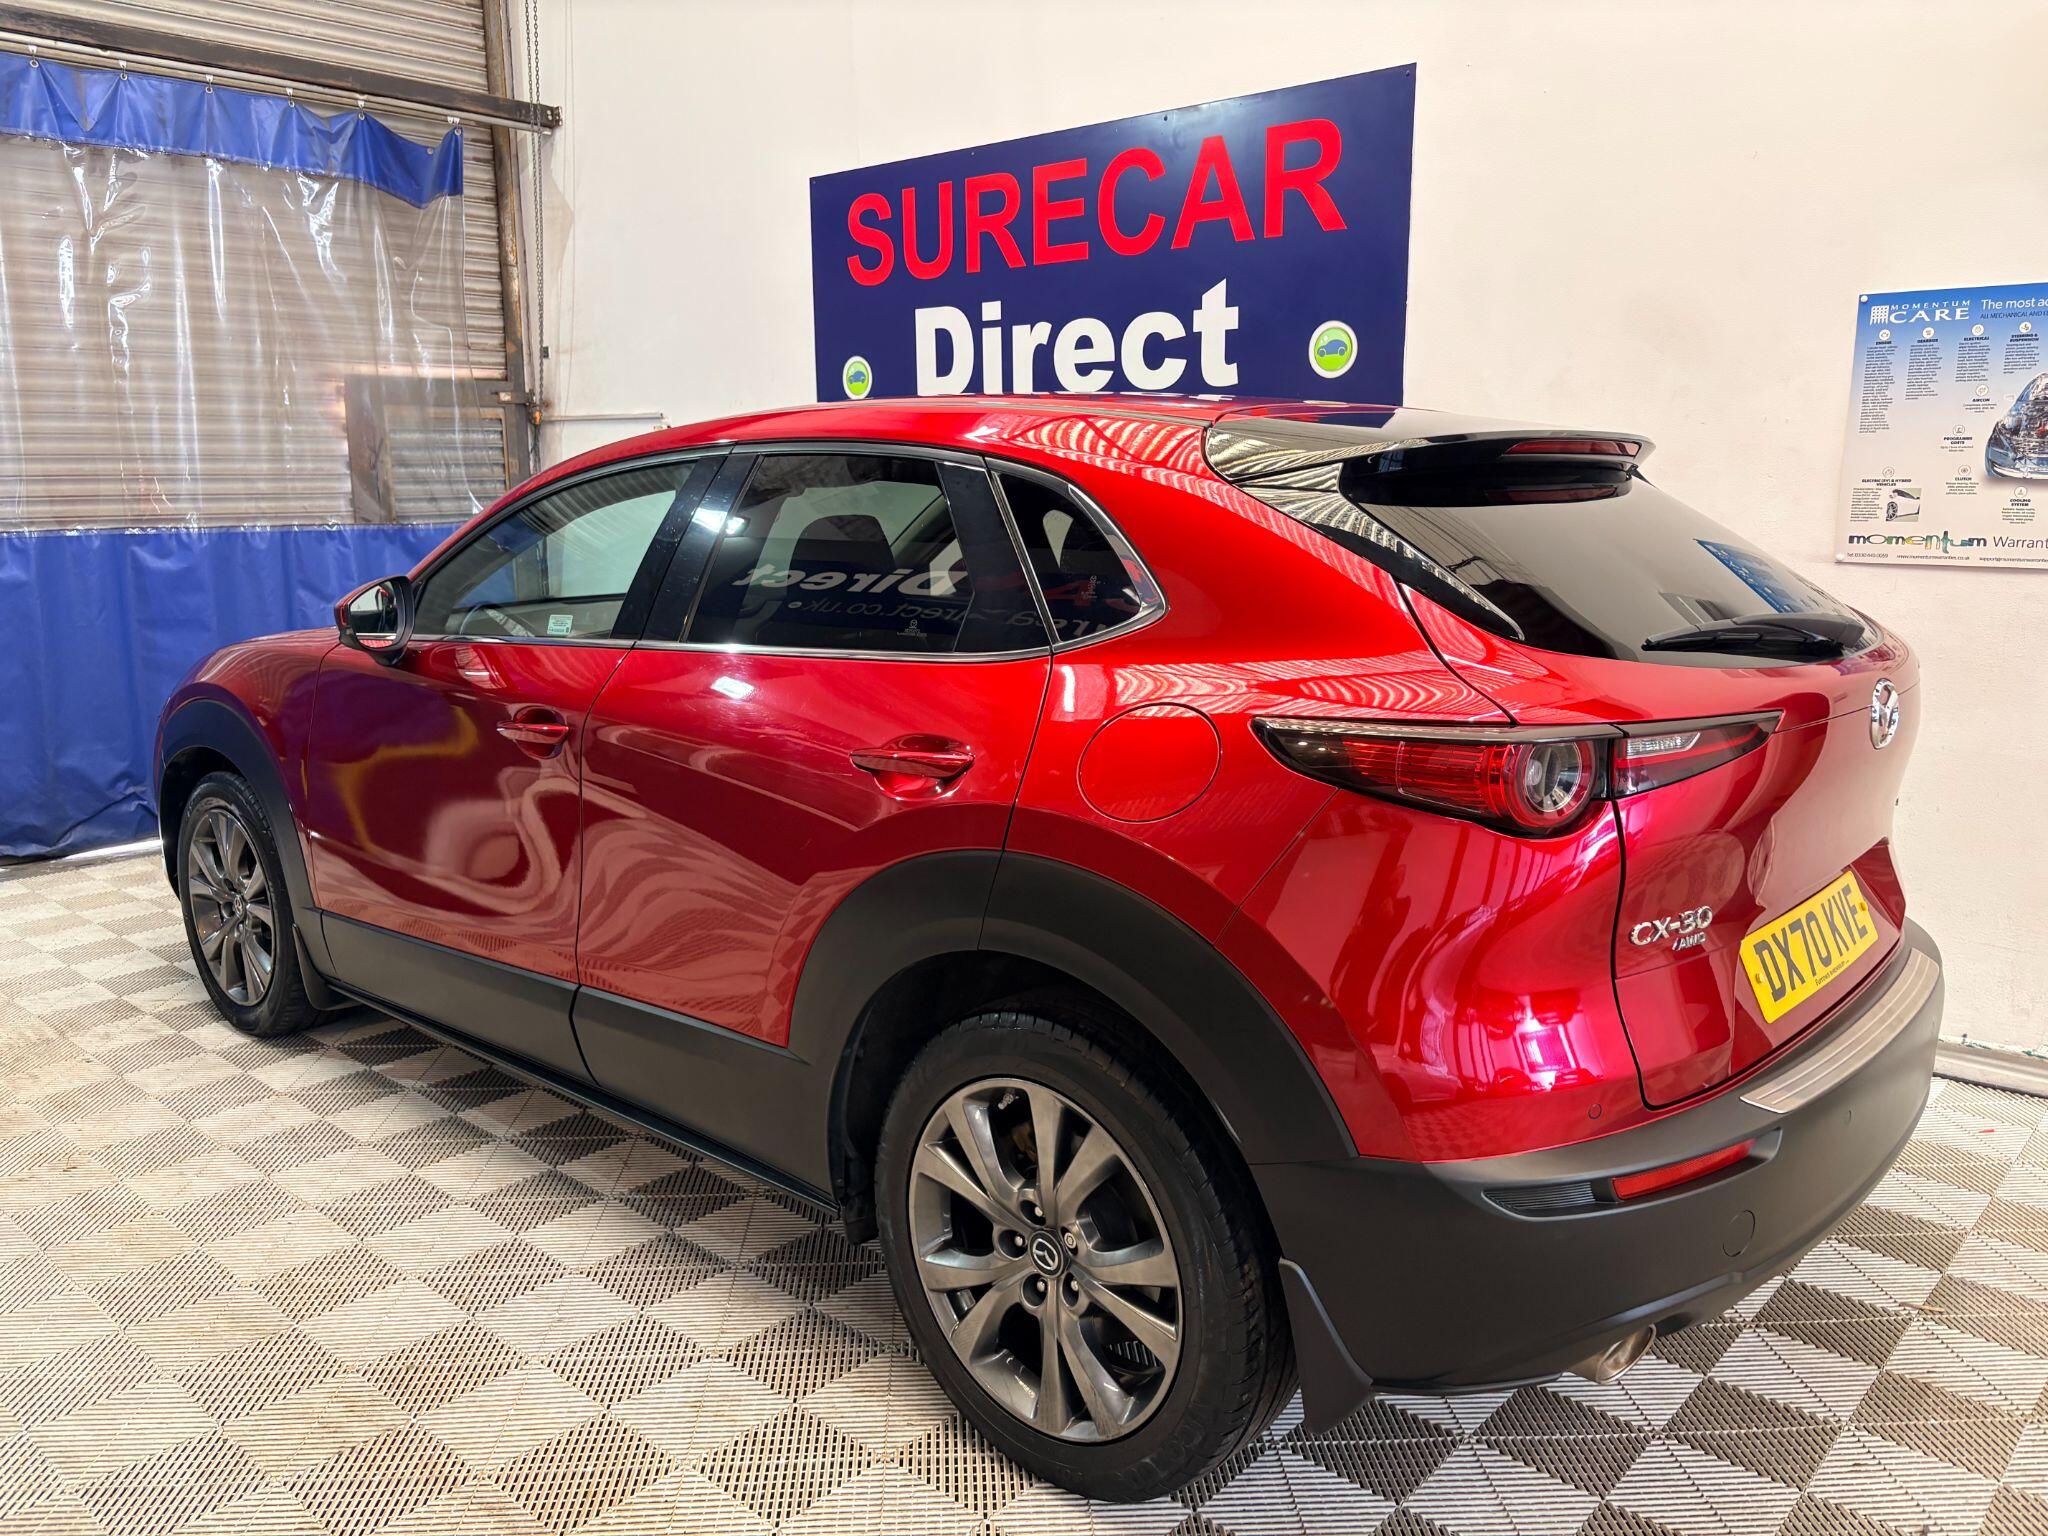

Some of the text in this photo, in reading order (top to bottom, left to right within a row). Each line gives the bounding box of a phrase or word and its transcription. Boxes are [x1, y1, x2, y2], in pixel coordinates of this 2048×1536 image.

[847, 118, 1348, 286] SURECAR
[1889, 308, 1970, 324] CARE
[1890, 300, 1970, 311] MOMENTUM
[1981, 299, 2003, 310] The
[2005, 297, 2035, 309] most
[914, 278, 1239, 396] Direct
[1848, 530, 1987, 554] momentum
[1629, 905, 1714, 947] CX-30
[1753, 883, 1869, 1003] DX70 KVE
